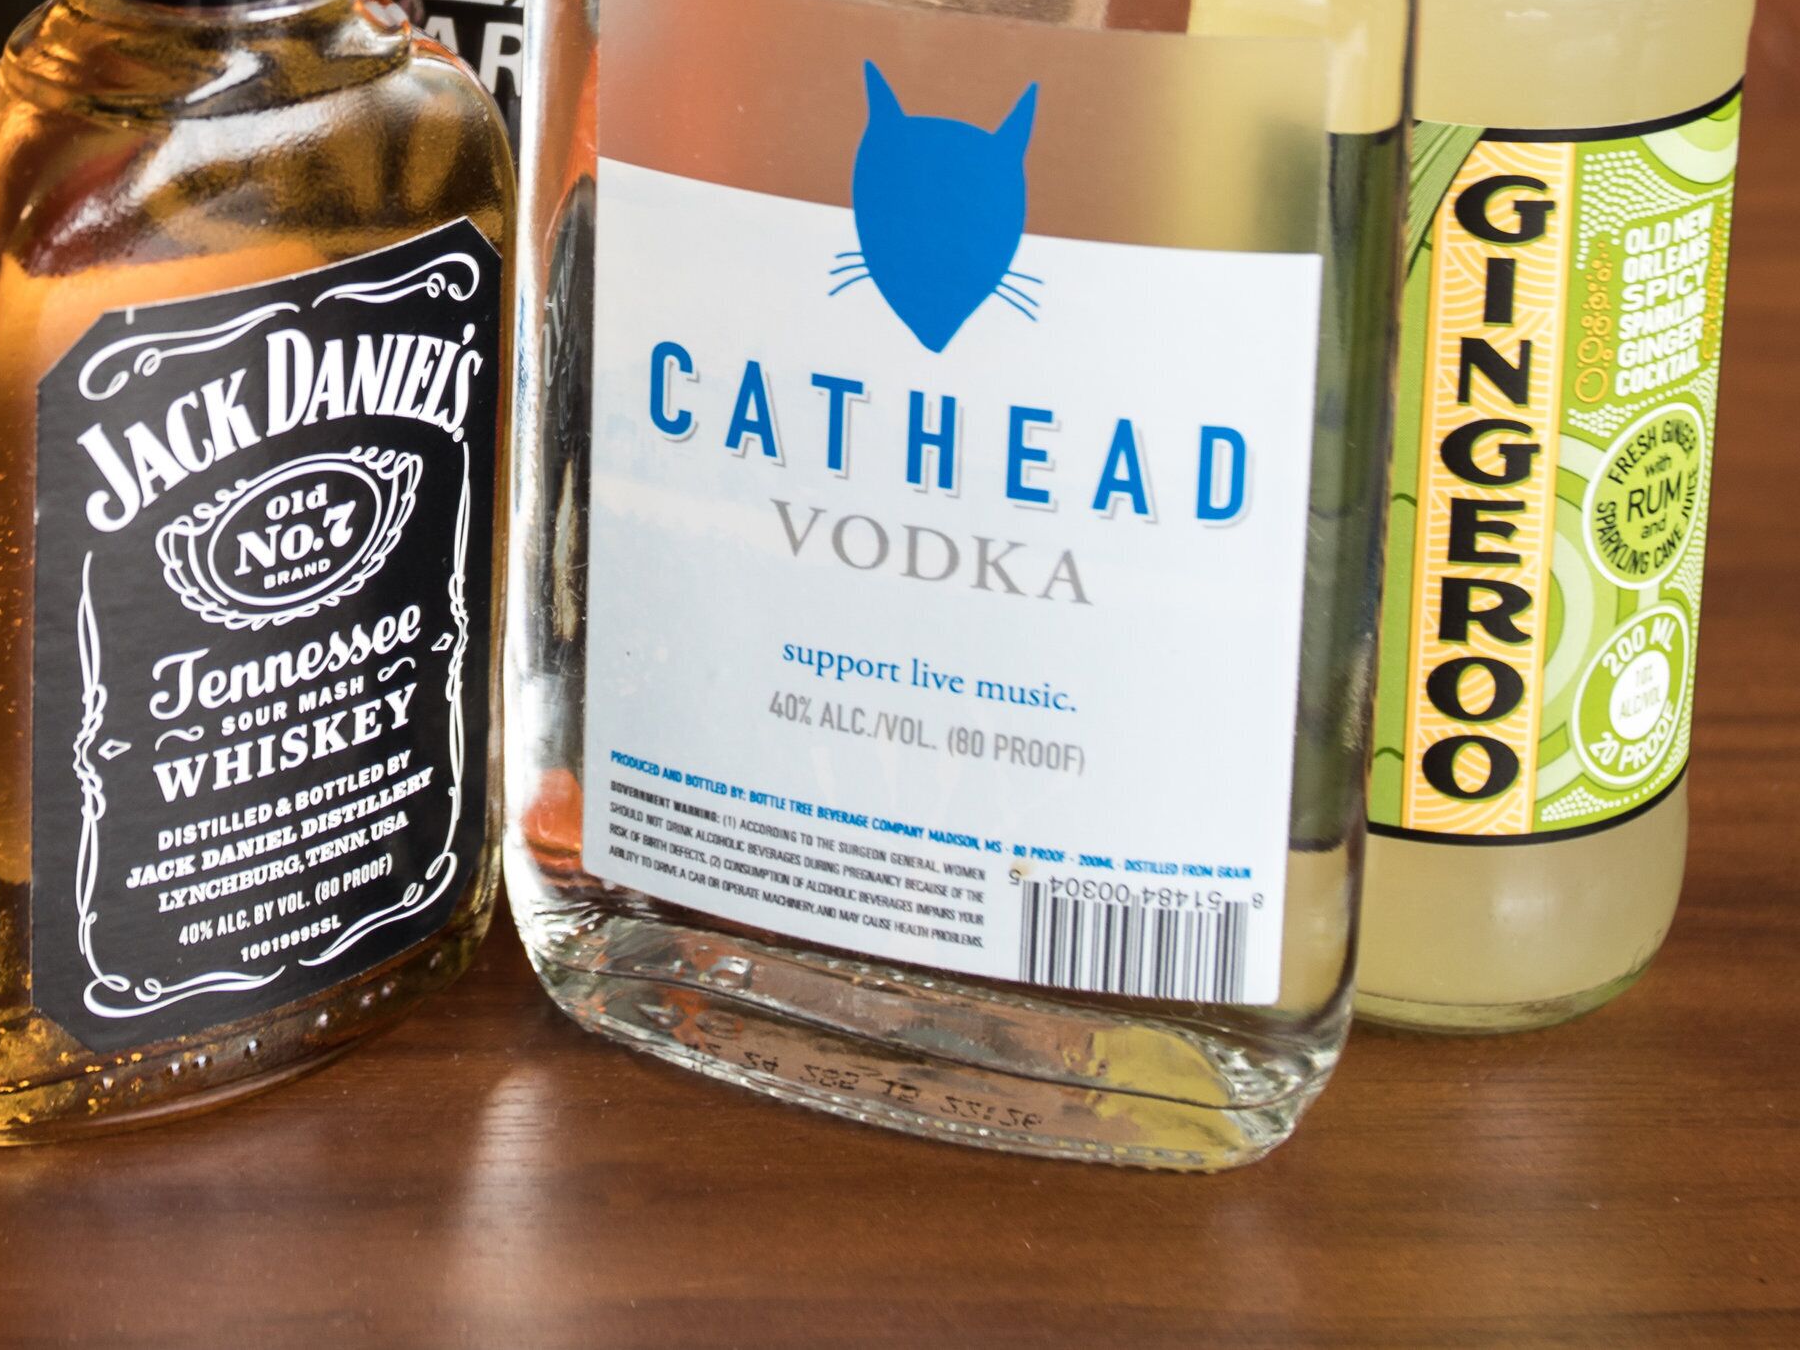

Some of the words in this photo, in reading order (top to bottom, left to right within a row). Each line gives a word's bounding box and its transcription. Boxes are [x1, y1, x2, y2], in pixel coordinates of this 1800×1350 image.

[1621, 231, 1711, 284] ORLEANS
[1624, 221, 1672, 255] OLD
[1673, 201, 1715, 243] NEW
[1620, 258, 1709, 312] SPICY
[1614, 344, 1701, 398] COCKTAIL
[1616, 315, 1704, 368] GINGER
[76, 368, 261, 533] JACK
[265, 323, 484, 442] DANIEL'S
[649, 340, 1255, 530] CATHEAD
[1606, 424, 1657, 486] FRESH
[265, 484, 328, 522] Old
[1421, 173, 1555, 801] GINGEROO
[1626, 469, 1683, 523] RUM
[1641, 512, 1666, 540] and
[263, 558, 331, 590] BRAND
[770, 497, 1093, 606] VODKA
[1596, 500, 1650, 576] SPARKLING
[149, 603, 421, 721] Tennessee
[781, 638, 900, 690] support
[909, 656, 965, 695] live
[974, 672, 1078, 714] music.
[1602, 624, 1647, 678] 200
[1649, 616, 1677, 652] ML
[152, 682, 418, 804] WHISKEY
[221, 701, 288, 737] SOUR
[298, 675, 365, 714] MASH
[768, 690, 813, 727] 40%
[818, 700, 938, 750] ALC./VOL.
[947, 724, 986, 759] (80
[992, 732, 1086, 777] PROOF)
[1589, 730, 1620, 766] 20
[1617, 698, 1674, 773] PROOF
[125, 851, 197, 890] JACK
[201, 824, 298, 874] DANIEL
[300, 766, 435, 846] DISTILLERY
[157, 802, 272, 851] DISTILLED
[275, 799, 292, 819] &
[295, 766, 385, 813] BOTTLED
[385, 750, 413, 781] BY
[610, 750, 660, 776] PRODUCED
[662, 767, 682, 783] AND
[685, 773, 727, 795] BOTTLED
[730, 785, 746, 801] BY:
[750, 790, 786, 810] BOTTLE
[790, 799, 813, 817] TREE
[817, 805, 869, 829] BEVERAGE
[872, 817, 924, 840] COMPANY
[984, 841, 1001, 854] MS
[1030, 846, 1065, 862] PROOF
[1125, 859, 1178, 876] DISTILLED
[1182, 863, 1212, 877] FROM
[1217, 866, 1252, 880] GRAIN
[610, 780, 670, 809] GOVERNMENT
[673, 801, 720, 824] WARNING:
[723, 814, 737, 830] (1)
[740, 819, 797, 843] ACCORDING
[800, 832, 813, 846] TO
[817, 836, 836, 851] THE
[839, 841, 886, 862] SURGEON
[943, 862, 986, 881] WOMEN
[157, 856, 305, 913] LYNCHBURG,
[305, 829, 371, 872] TENN.
[371, 811, 409, 843] USA
[609, 823, 629, 839] RISK
[630, 830, 641, 842] OF
[643, 834, 667, 851] BIRTH
[709, 854, 722, 869] (2)
[723, 858, 790, 886] CONSUMPTION
[793, 876, 804, 889] OF
[806, 879, 856, 901] ALCOHOLIC
[859, 890, 913, 913] BEVERAGES
[916, 902, 955, 922] IMPAIRS
[958, 911, 984, 927] YOUR
[609, 845, 639, 864] ABILITY
[642, 855, 652, 869] TO
[654, 860, 678, 876] DRIVE
[688, 870, 706, 885] CAR
[708, 876, 721, 889] OR
[722, 880, 760, 899] OPERATE
[817, 904, 837, 919] AND
[839, 908, 860, 924] MAY
[862, 913, 892, 931] CAUSE
[894, 919, 929, 938] HEALTH
[610, 801, 643, 823] SHOULD
[646, 814, 664, 829] NOT
[666, 819, 693, 837] DRINK
[695, 830, 744, 852] ALCOHOLIC
[747, 844, 801, 866] BEVERAGES
[804, 856, 840, 875] DURING
[843, 865, 902, 888] PREGNANCY
[905, 878, 948, 897] BECAUSE
[951, 887, 963, 899] OF
[967, 889, 984, 904] THE
[179, 916, 213, 947] 40%
[216, 905, 252, 940] ALC.
[253, 895, 275, 924] BY
[276, 882, 312, 916] VOL.
[314, 871, 342, 907] (80
[342, 852, 394, 892] PROOF)
